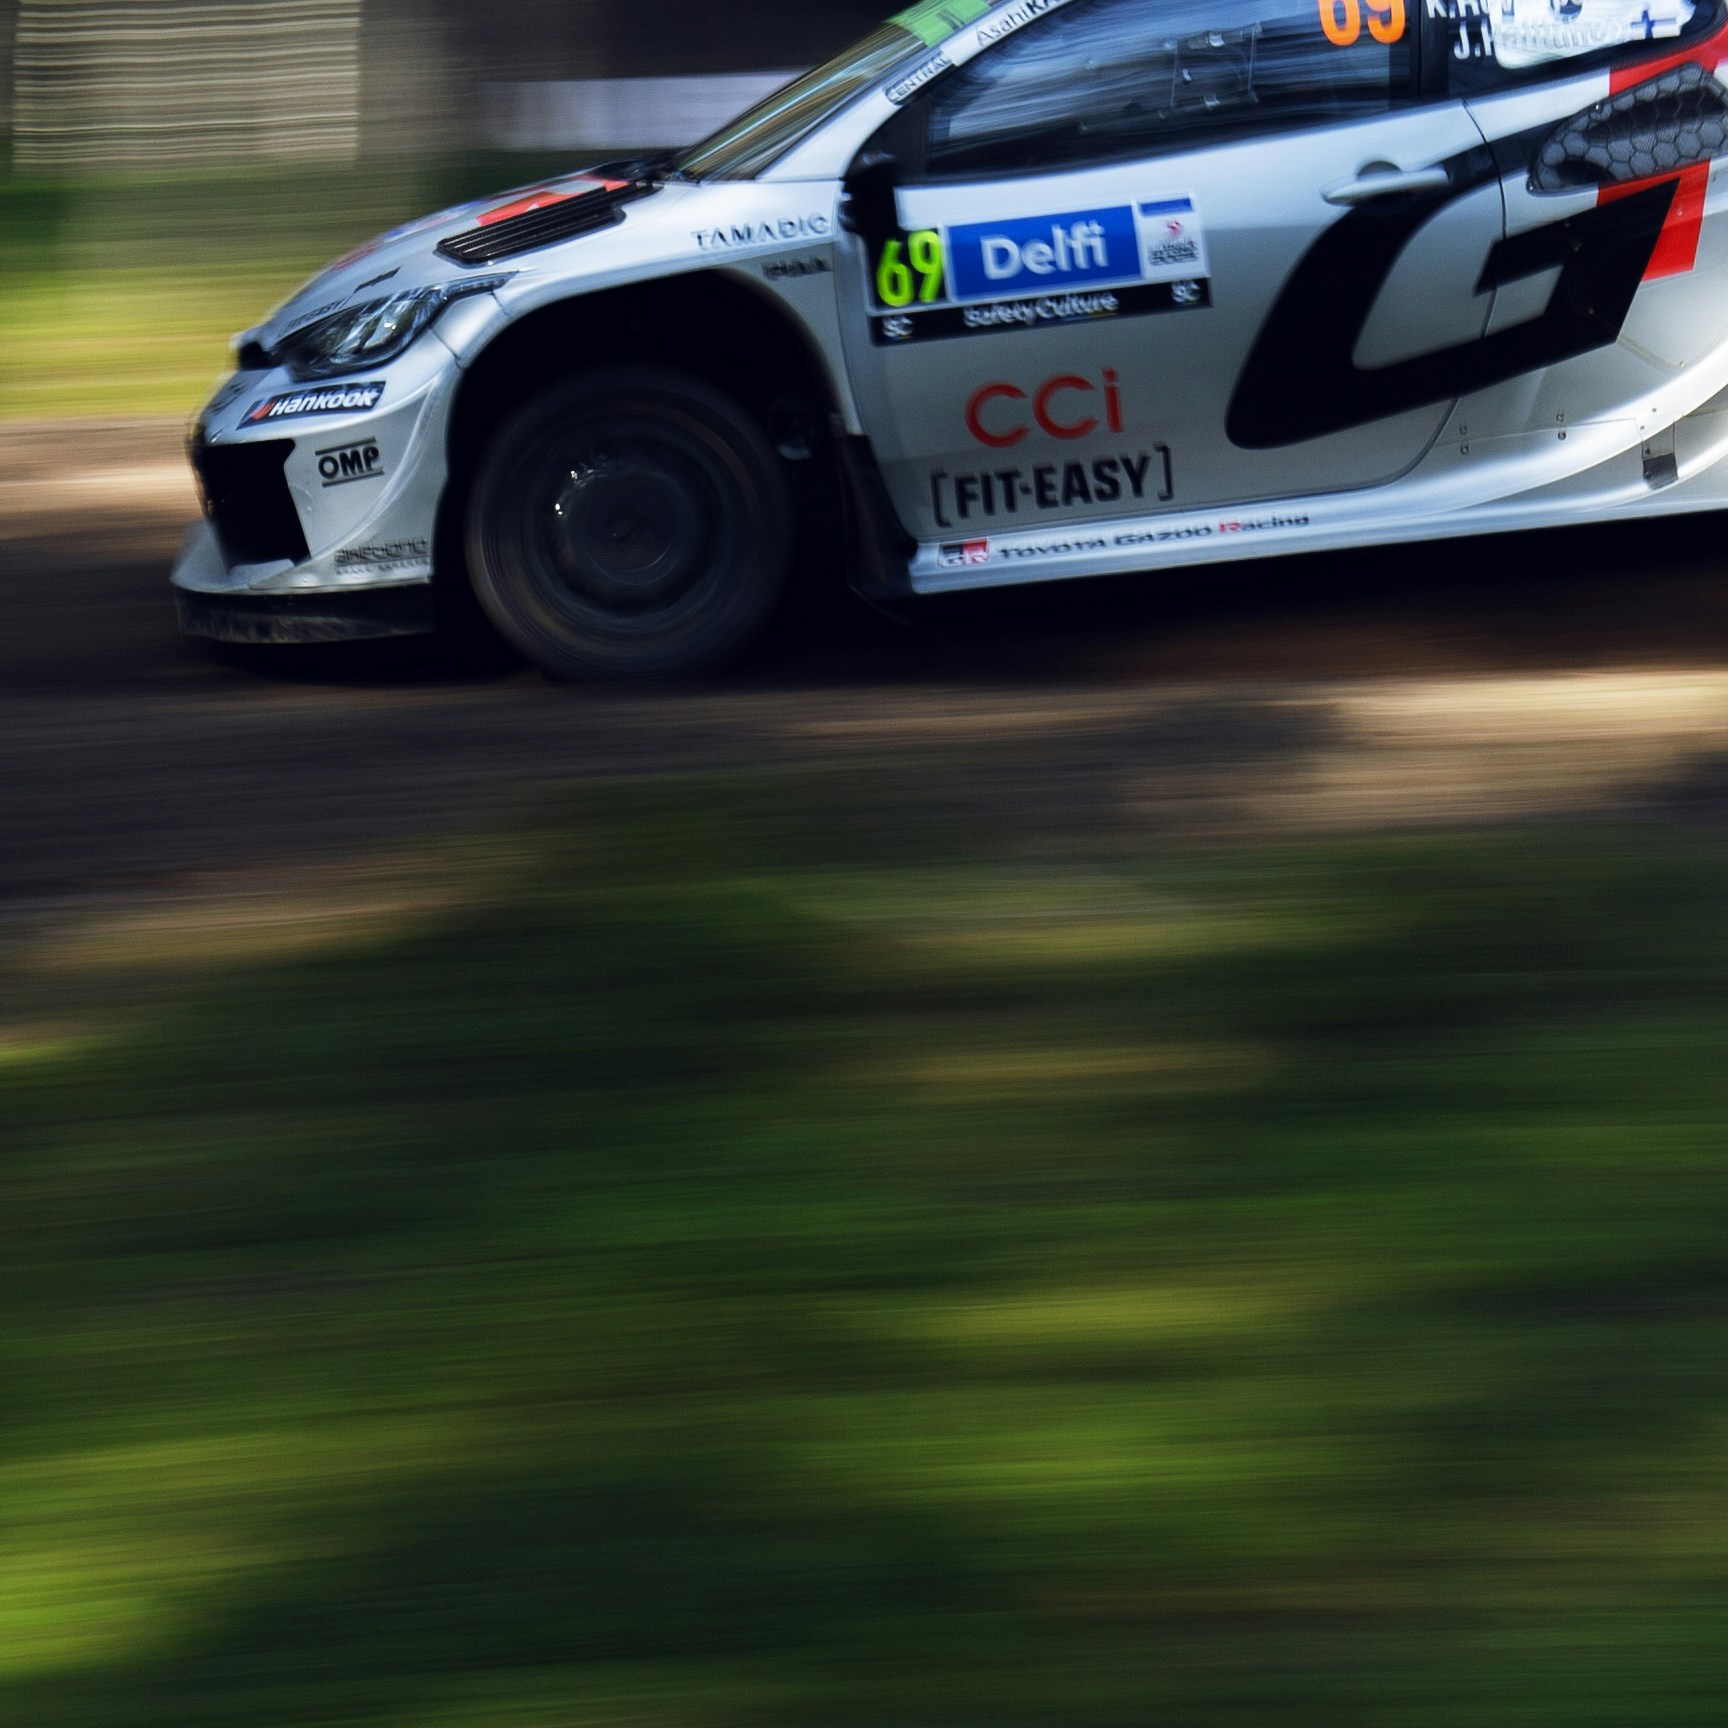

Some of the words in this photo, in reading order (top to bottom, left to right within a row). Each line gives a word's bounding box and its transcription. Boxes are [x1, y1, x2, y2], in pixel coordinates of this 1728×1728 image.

[691, 212, 829, 250] TAMADIC
[877, 230, 944, 307] 69
[981, 219, 1110, 280] Delfi
[318, 445, 381, 480] OMP
[998, 539, 1106, 561] TOYOTA
